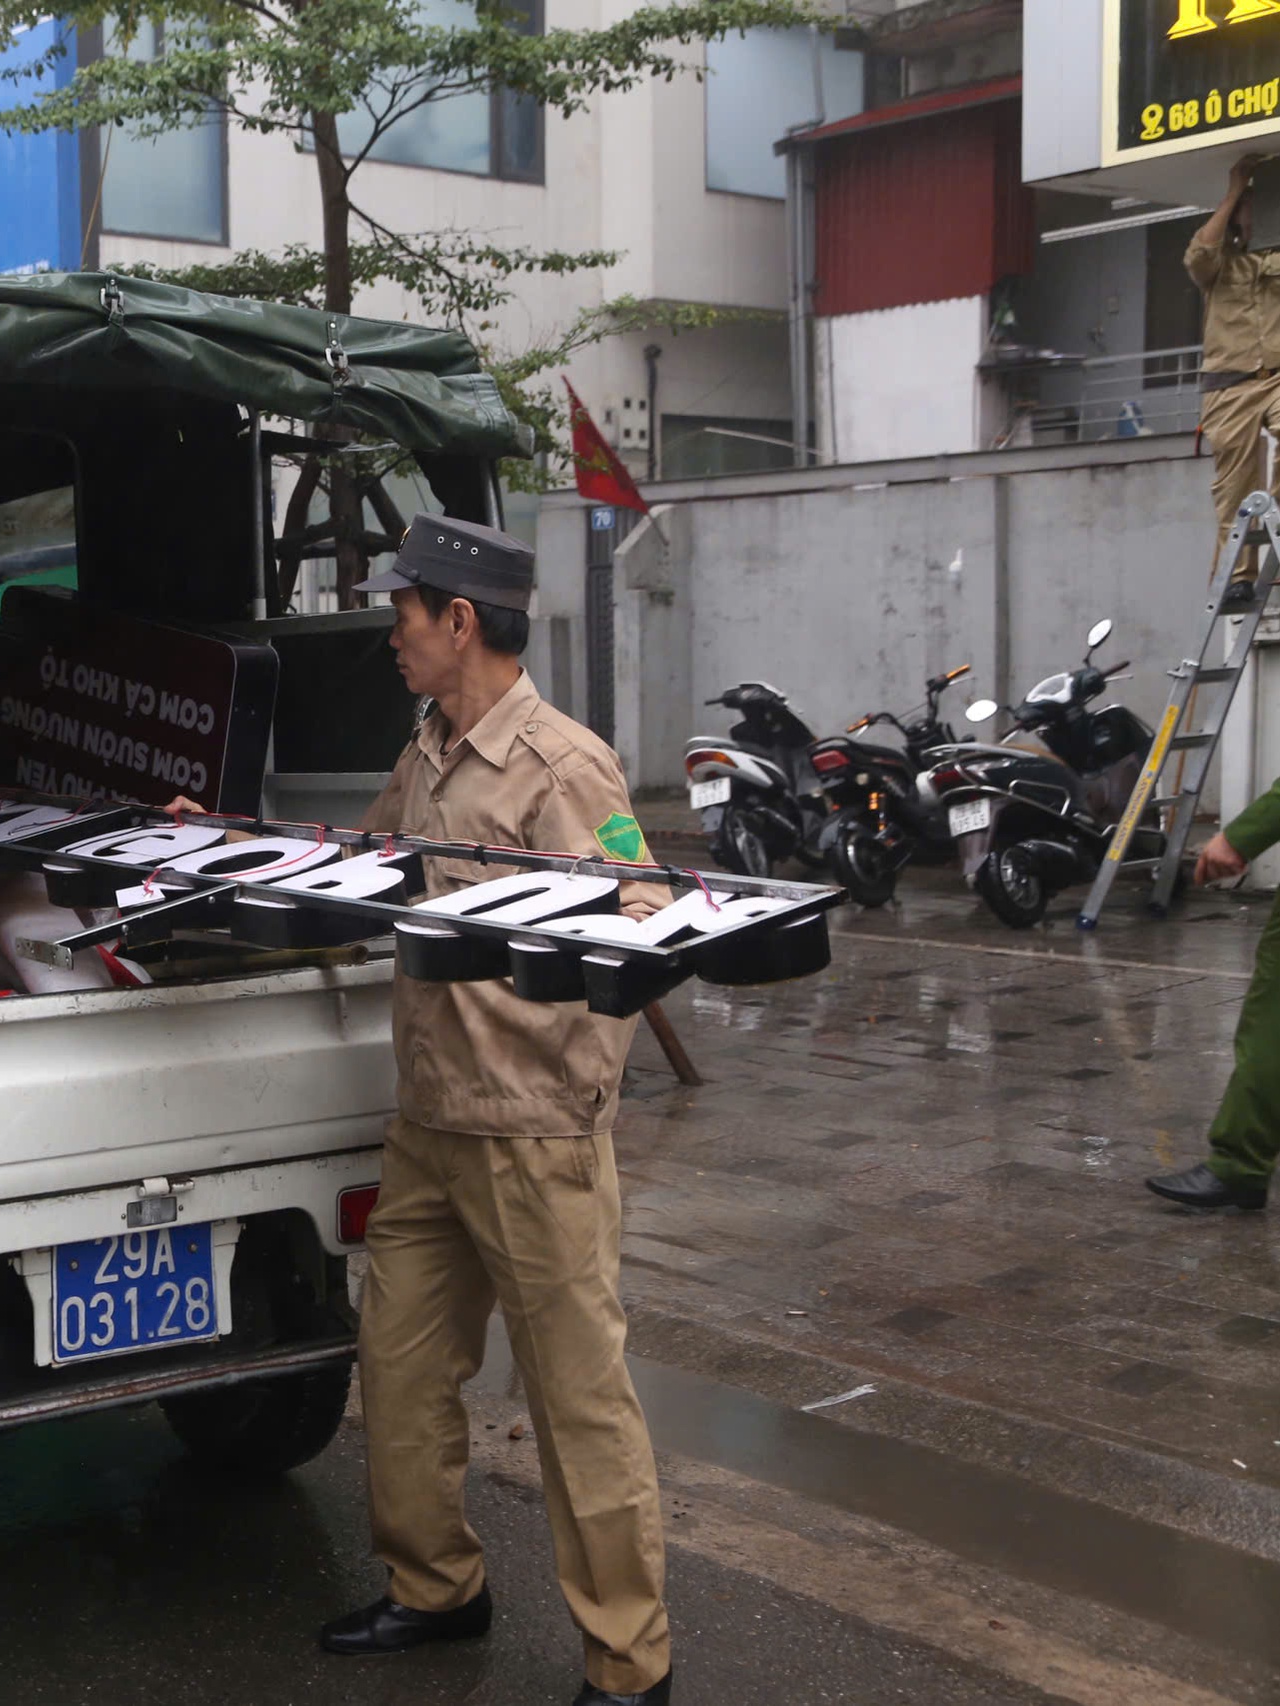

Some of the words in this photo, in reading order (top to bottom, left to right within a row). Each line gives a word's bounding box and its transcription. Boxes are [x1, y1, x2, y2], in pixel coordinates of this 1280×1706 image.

[1169, 100, 1199, 131] 68
[1205, 89, 1222, 124] Ô
[1228, 77, 1280, 118] CHỢ
[72, 664, 120, 705] KHO
[122, 678, 156, 718] CÁ
[158, 690, 215, 736] CƠM
[150, 746, 208, 793] CƠM
[94, 1228, 176, 1285] 29A
[61, 1277, 210, 1351] 031.28
